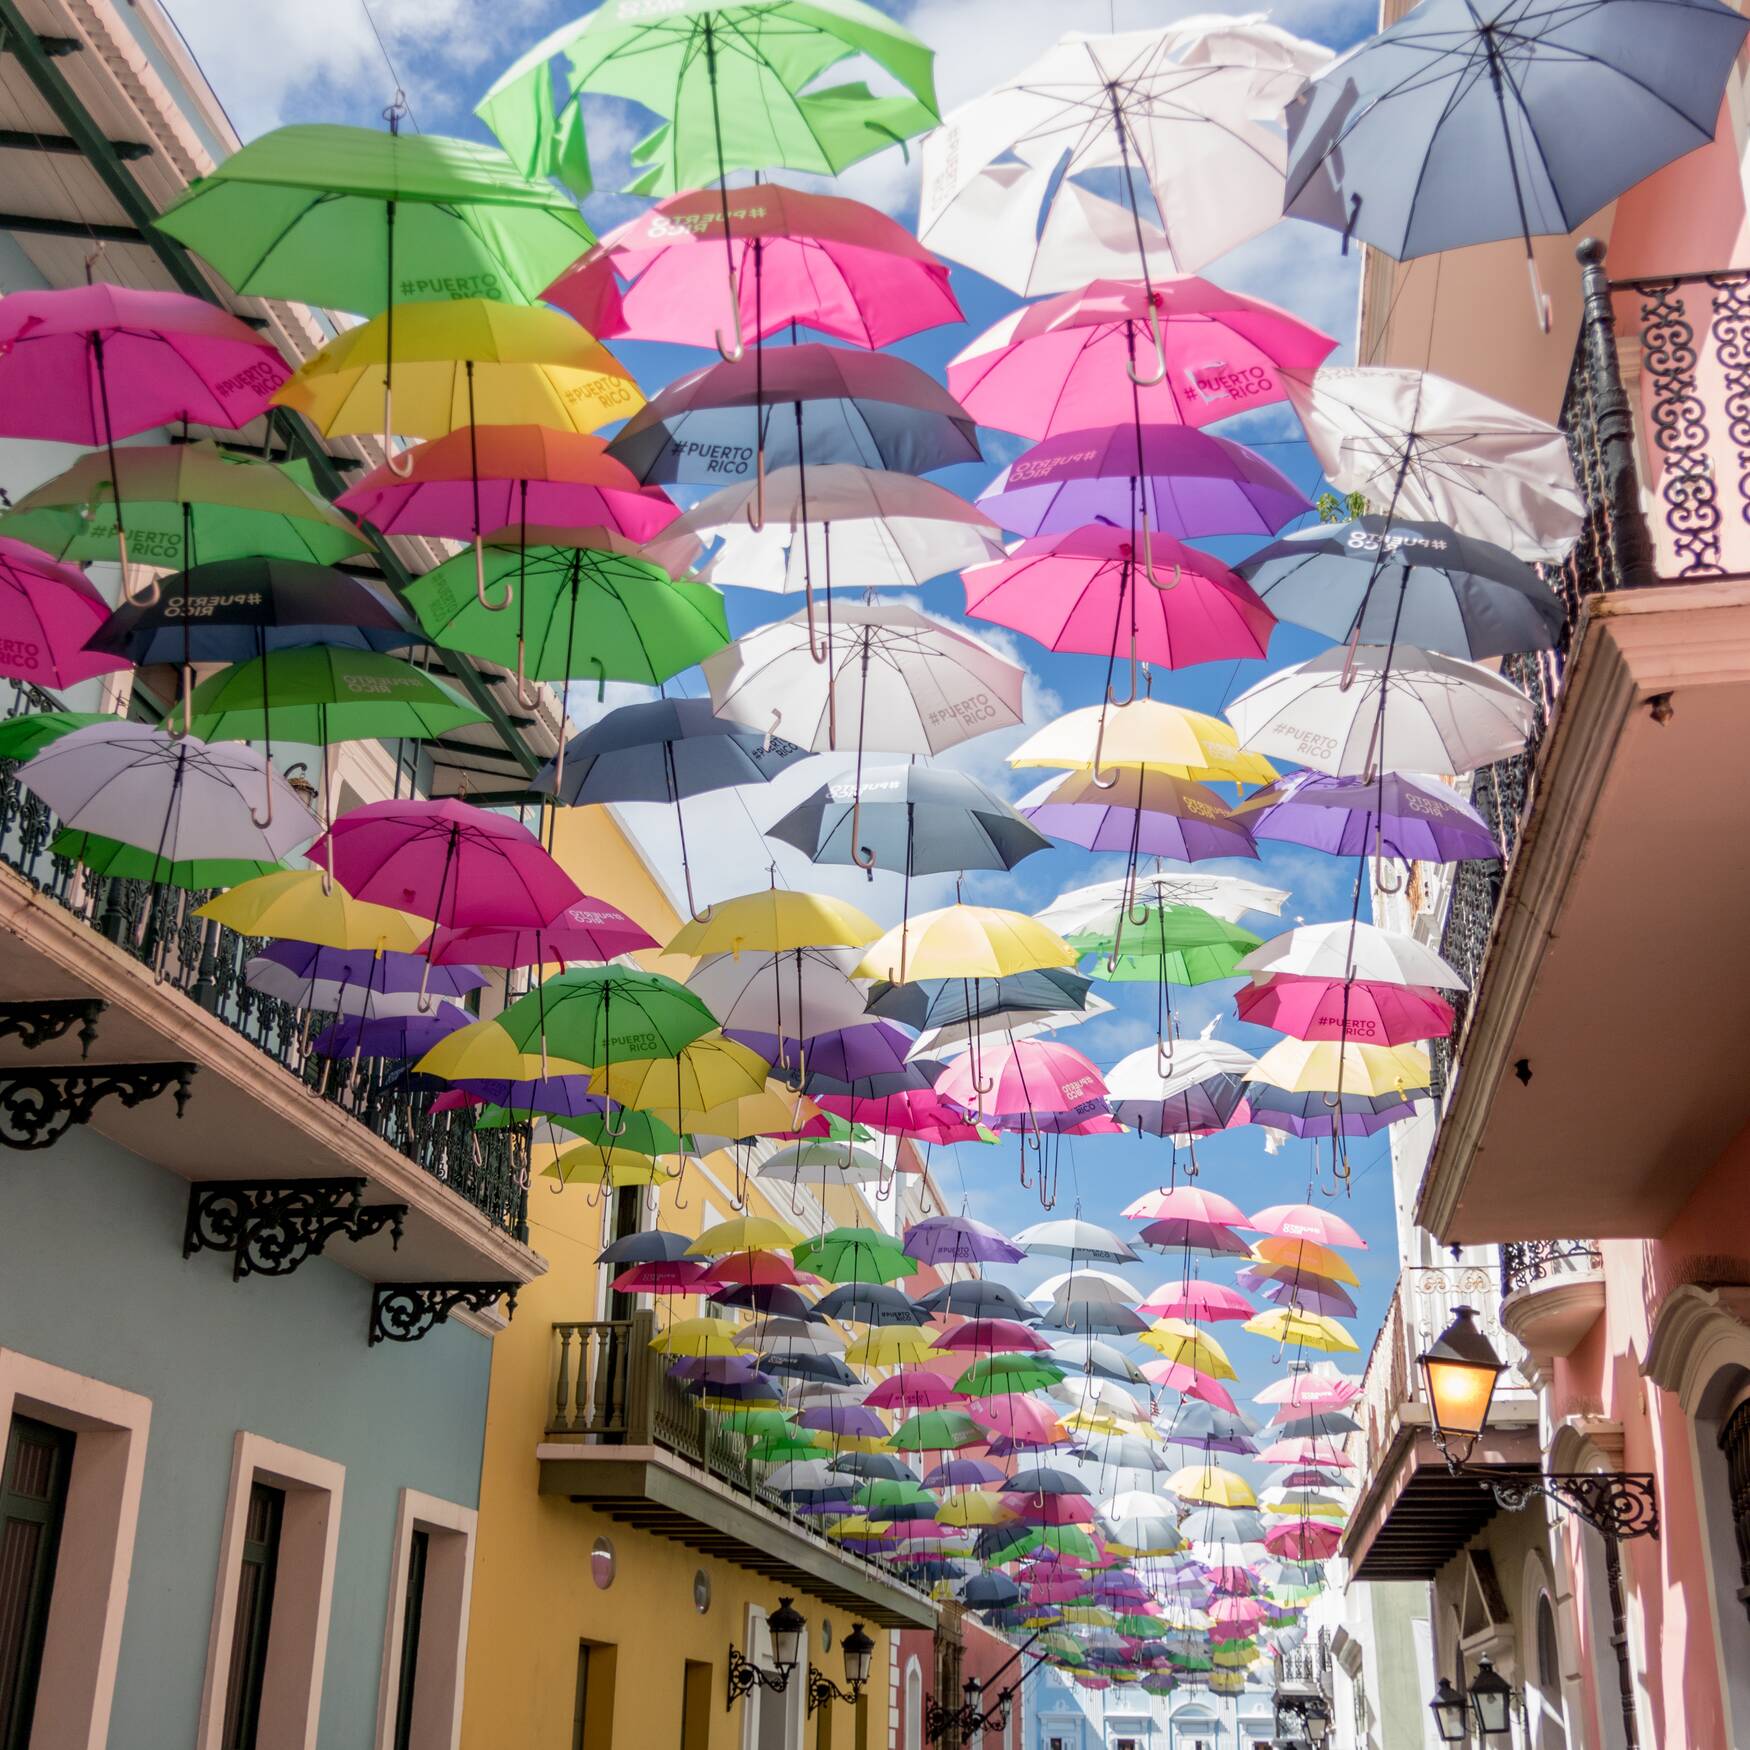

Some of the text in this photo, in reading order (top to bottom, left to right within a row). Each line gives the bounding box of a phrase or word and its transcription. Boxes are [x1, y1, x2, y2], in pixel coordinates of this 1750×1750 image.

[401, 273, 497, 296] #PUERTO
[215, 362, 273, 398] #PUERTO
[250, 374, 285, 398] RICO
[565, 376, 621, 404] #PUERTO
[1183, 366, 1265, 401] #PUERTO
[1230, 378, 1273, 401] RICO
[598, 388, 631, 409] RICO
[671, 440, 753, 461] #PUERTO
[707, 459, 748, 474] RICO
[90, 525, 182, 546] #PUERTO
[131, 541, 179, 558] RICO
[928, 693, 988, 726] #PUERTO
[962, 704, 996, 726] RICO
[1273, 722, 1338, 750] #PUERTO
[775, 742, 799, 759] RICO
[1297, 742, 1332, 760] RICO
[1318, 1016, 1376, 1029] #PUERTO
[1345, 1026, 1376, 1037] RICO
[602, 1033, 656, 1048] #PUERTO
[629, 1041, 657, 1053] RICO
[1076, 1102, 1096, 1115] RICO
